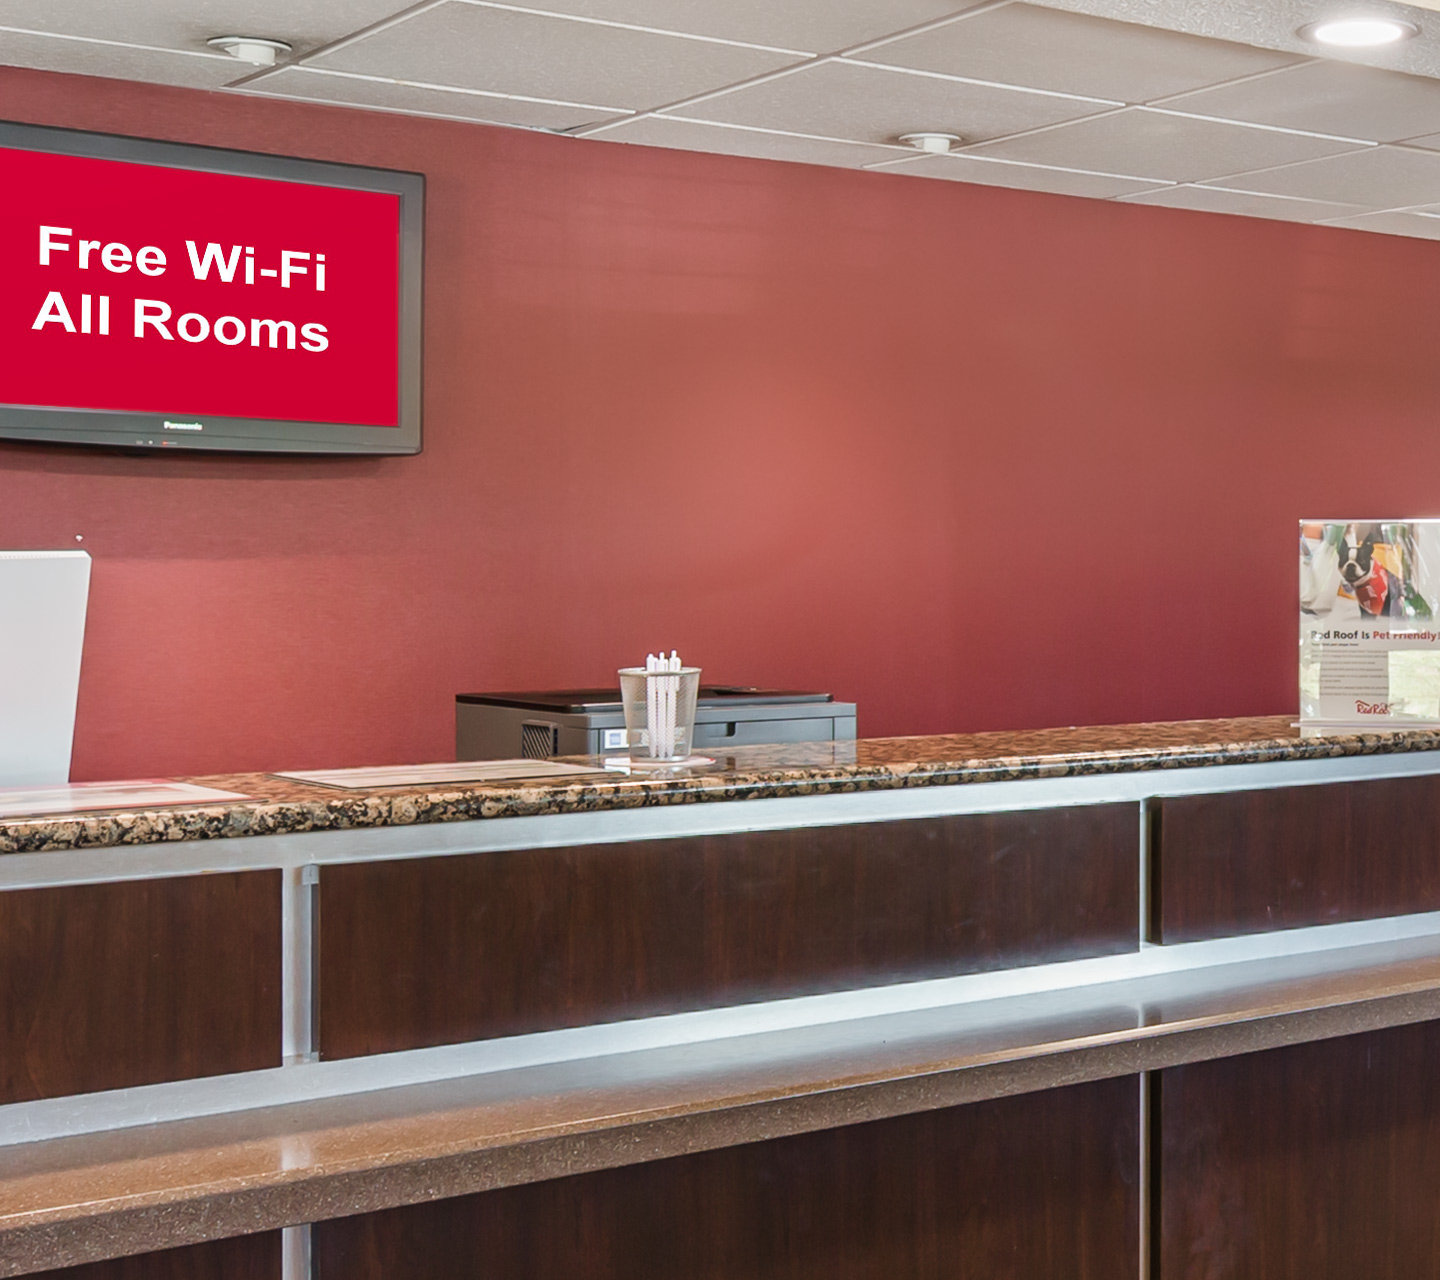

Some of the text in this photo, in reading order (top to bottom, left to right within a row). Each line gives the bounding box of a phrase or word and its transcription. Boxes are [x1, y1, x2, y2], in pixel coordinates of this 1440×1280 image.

[38, 225, 327, 292] Free Wi-Fi
[32, 291, 330, 353] All Rooms
[1333, 630, 1359, 640] Roof
[1372, 630, 1391, 640] Pet
